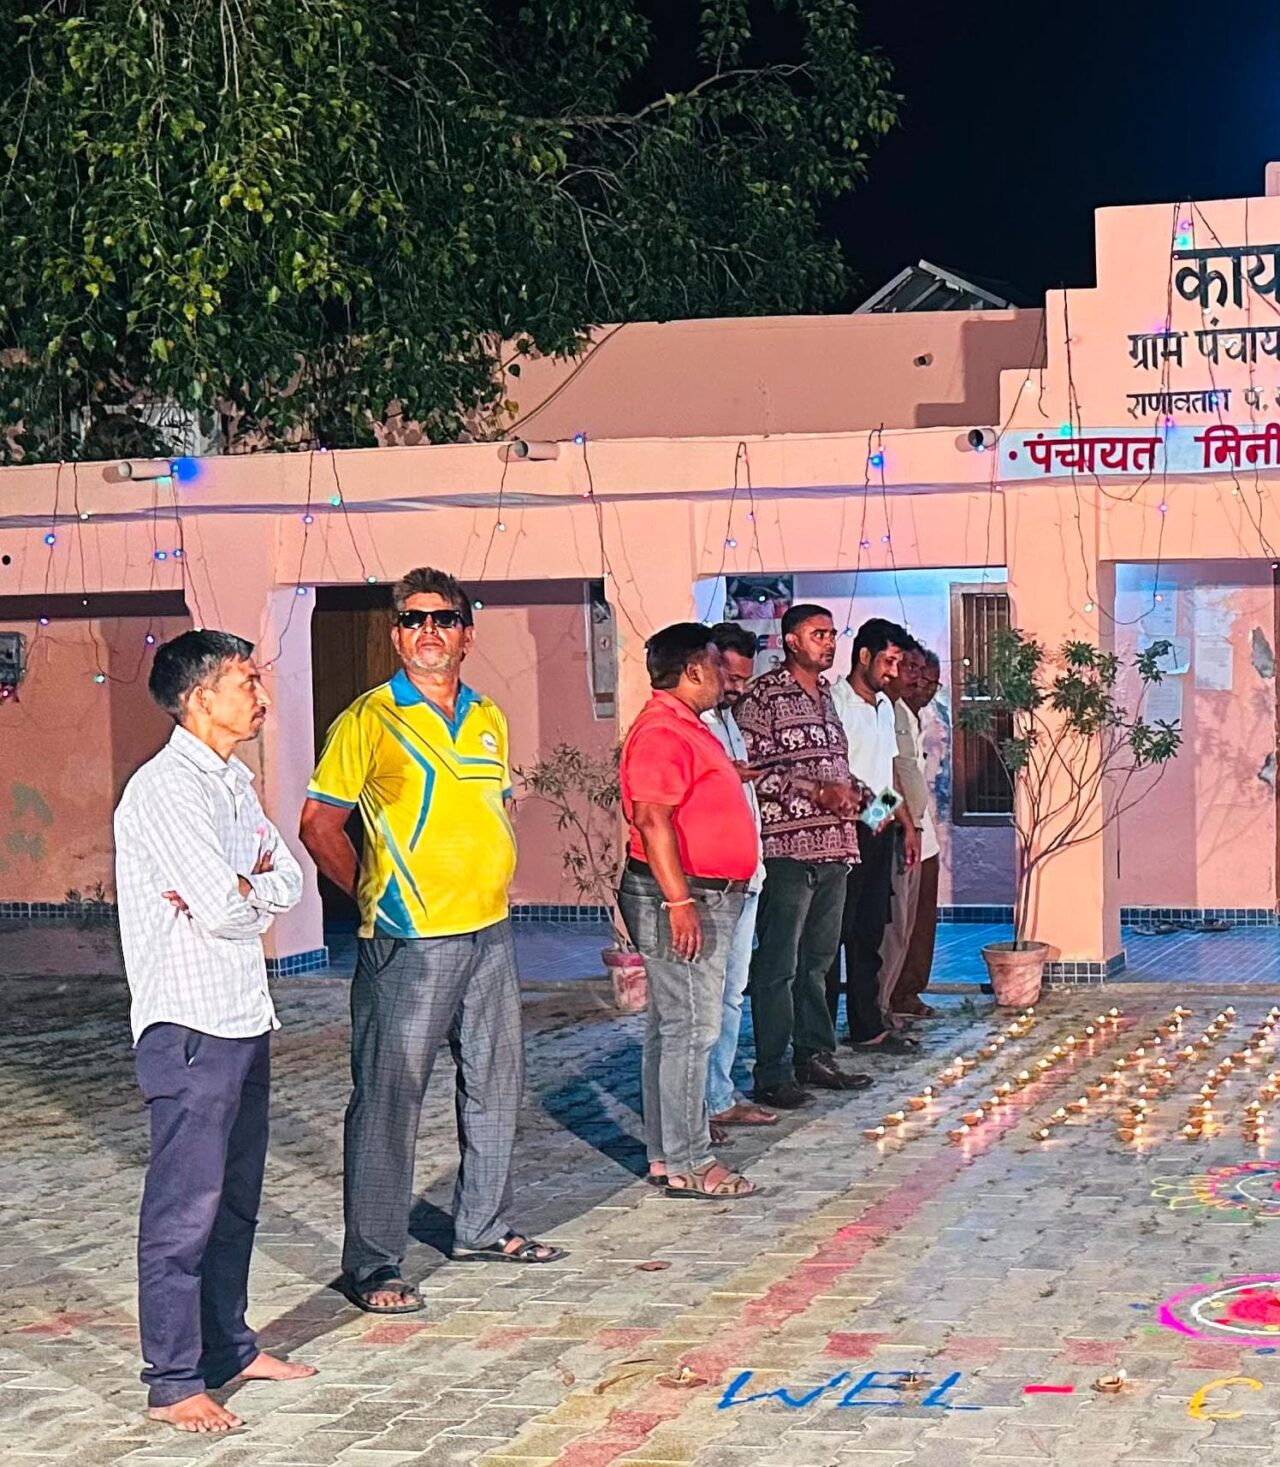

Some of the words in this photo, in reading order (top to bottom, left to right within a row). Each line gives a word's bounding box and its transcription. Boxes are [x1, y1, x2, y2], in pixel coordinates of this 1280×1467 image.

[1128, 331, 1189, 370] ग्राम
[1024, 433, 1163, 473] पंचायत
[717, 1371, 982, 1411] WEL
